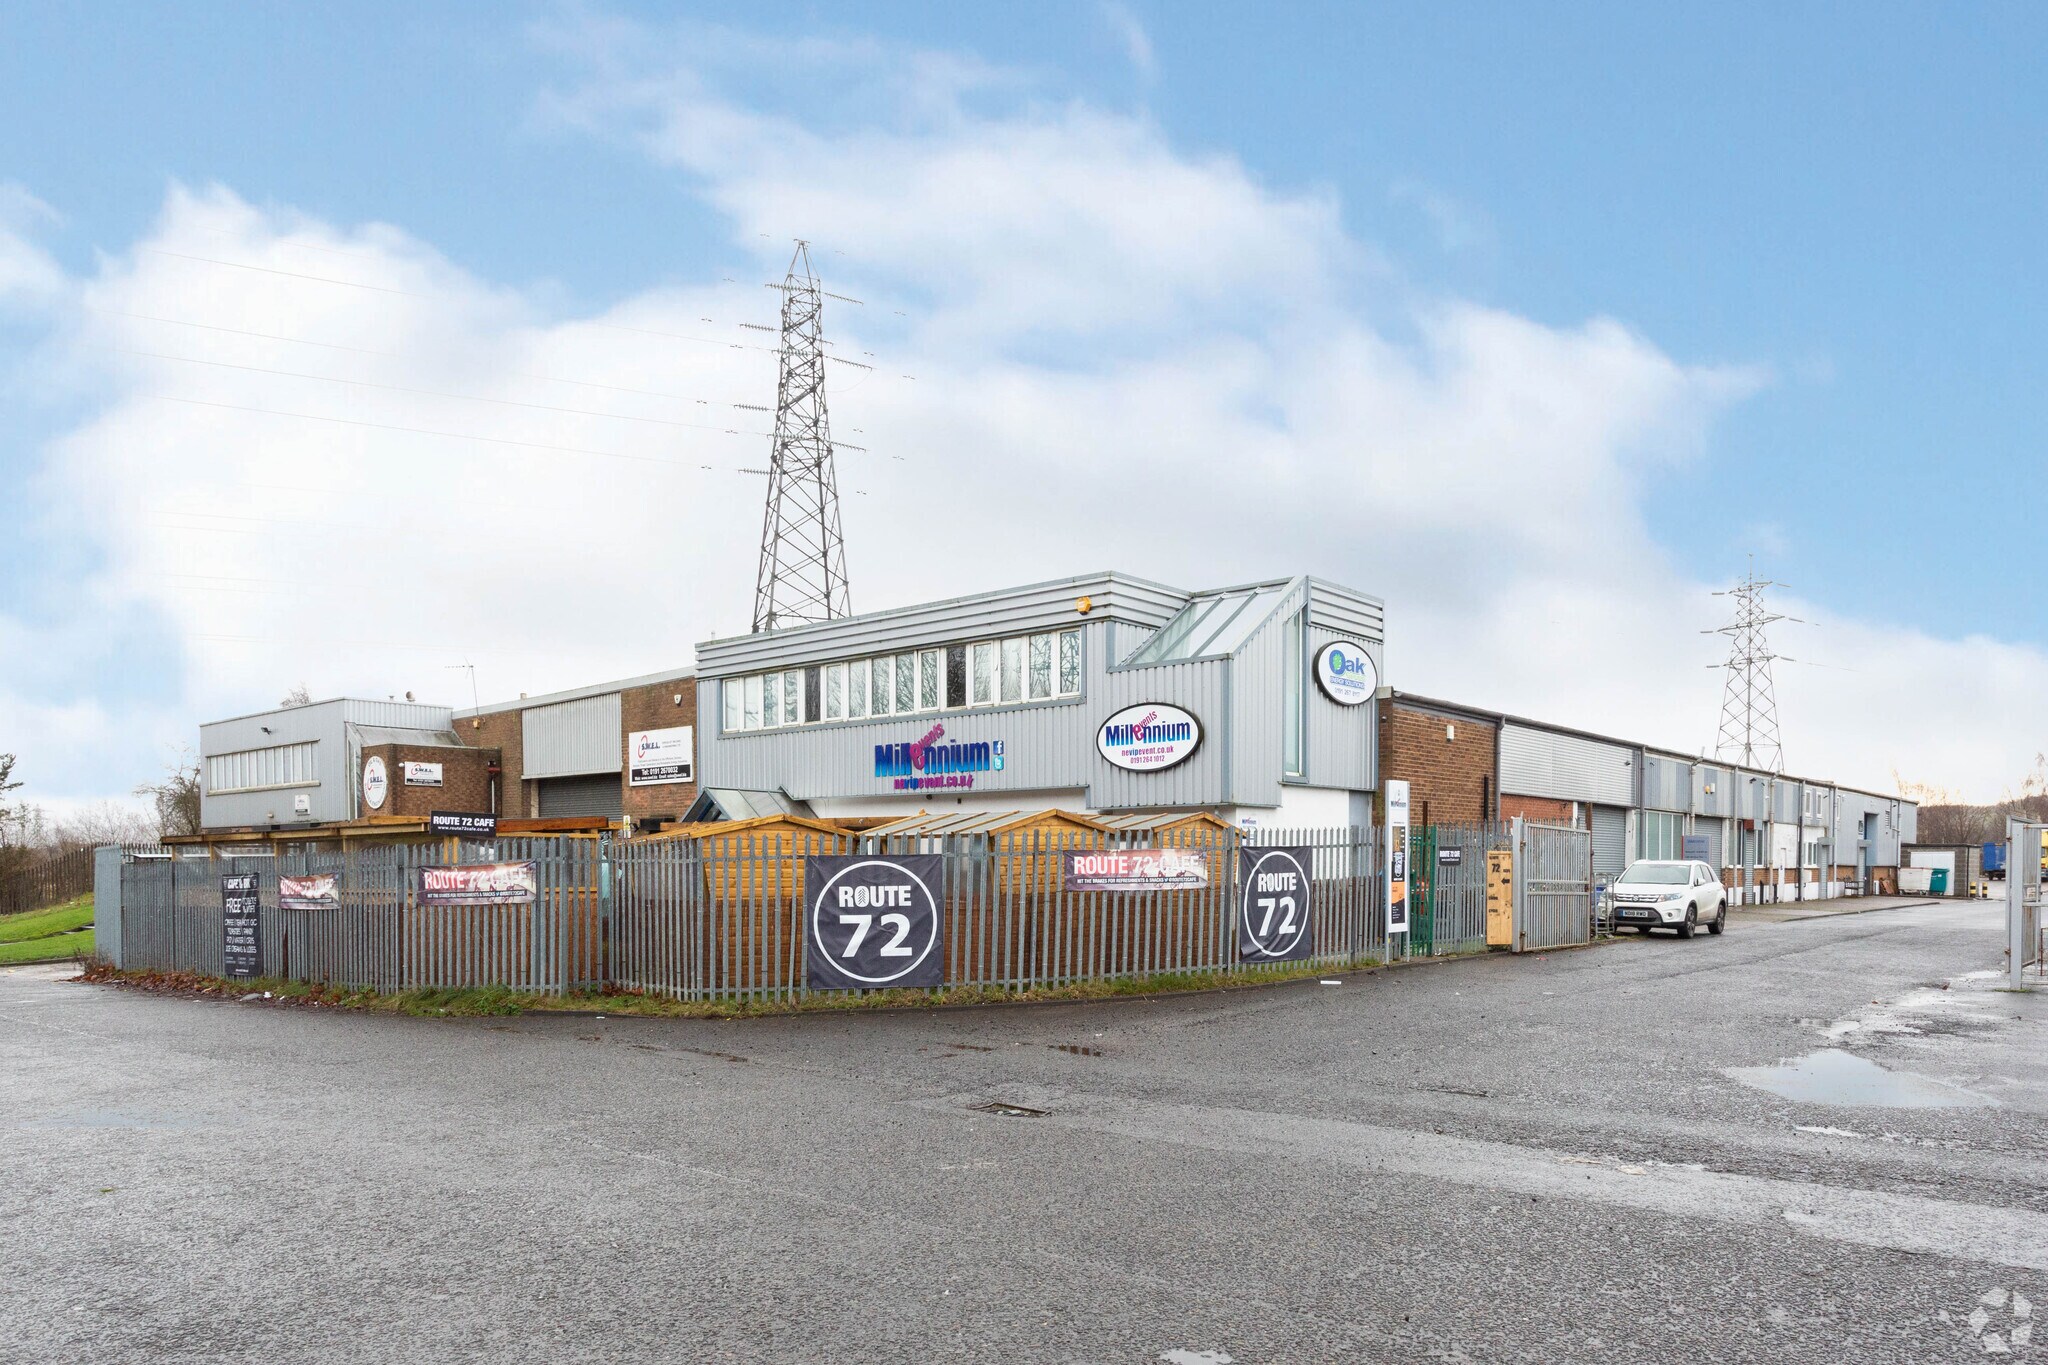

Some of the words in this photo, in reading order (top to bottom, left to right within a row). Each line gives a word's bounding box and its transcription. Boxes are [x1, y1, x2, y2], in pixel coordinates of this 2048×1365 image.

[1329, 650, 1365, 675] Oak
[1105, 720, 1190, 746] Millennium
[875, 739, 990, 777] Millennium
[1121, 745, 1174, 757] nevipevent.co.uk
[894, 774, 974, 790] nevipevent.co.uk
[433, 816, 459, 825] ROUTE
[462, 817, 472, 826] 72
[474, 818, 494, 827] CAFE
[1074, 856, 1128, 875] ROUTE
[1132, 856, 1153, 873] 72
[1160, 855, 1199, 871] CAFE
[1491, 864, 1501, 873] 72
[424, 871, 464, 889] ROUTE
[1257, 872, 1296, 892] ROUTE
[226, 898, 241, 913] FREE
[838, 885, 912, 908] ROUTE
[1257, 896, 1296, 937] 72
[839, 913, 913, 958] 72
